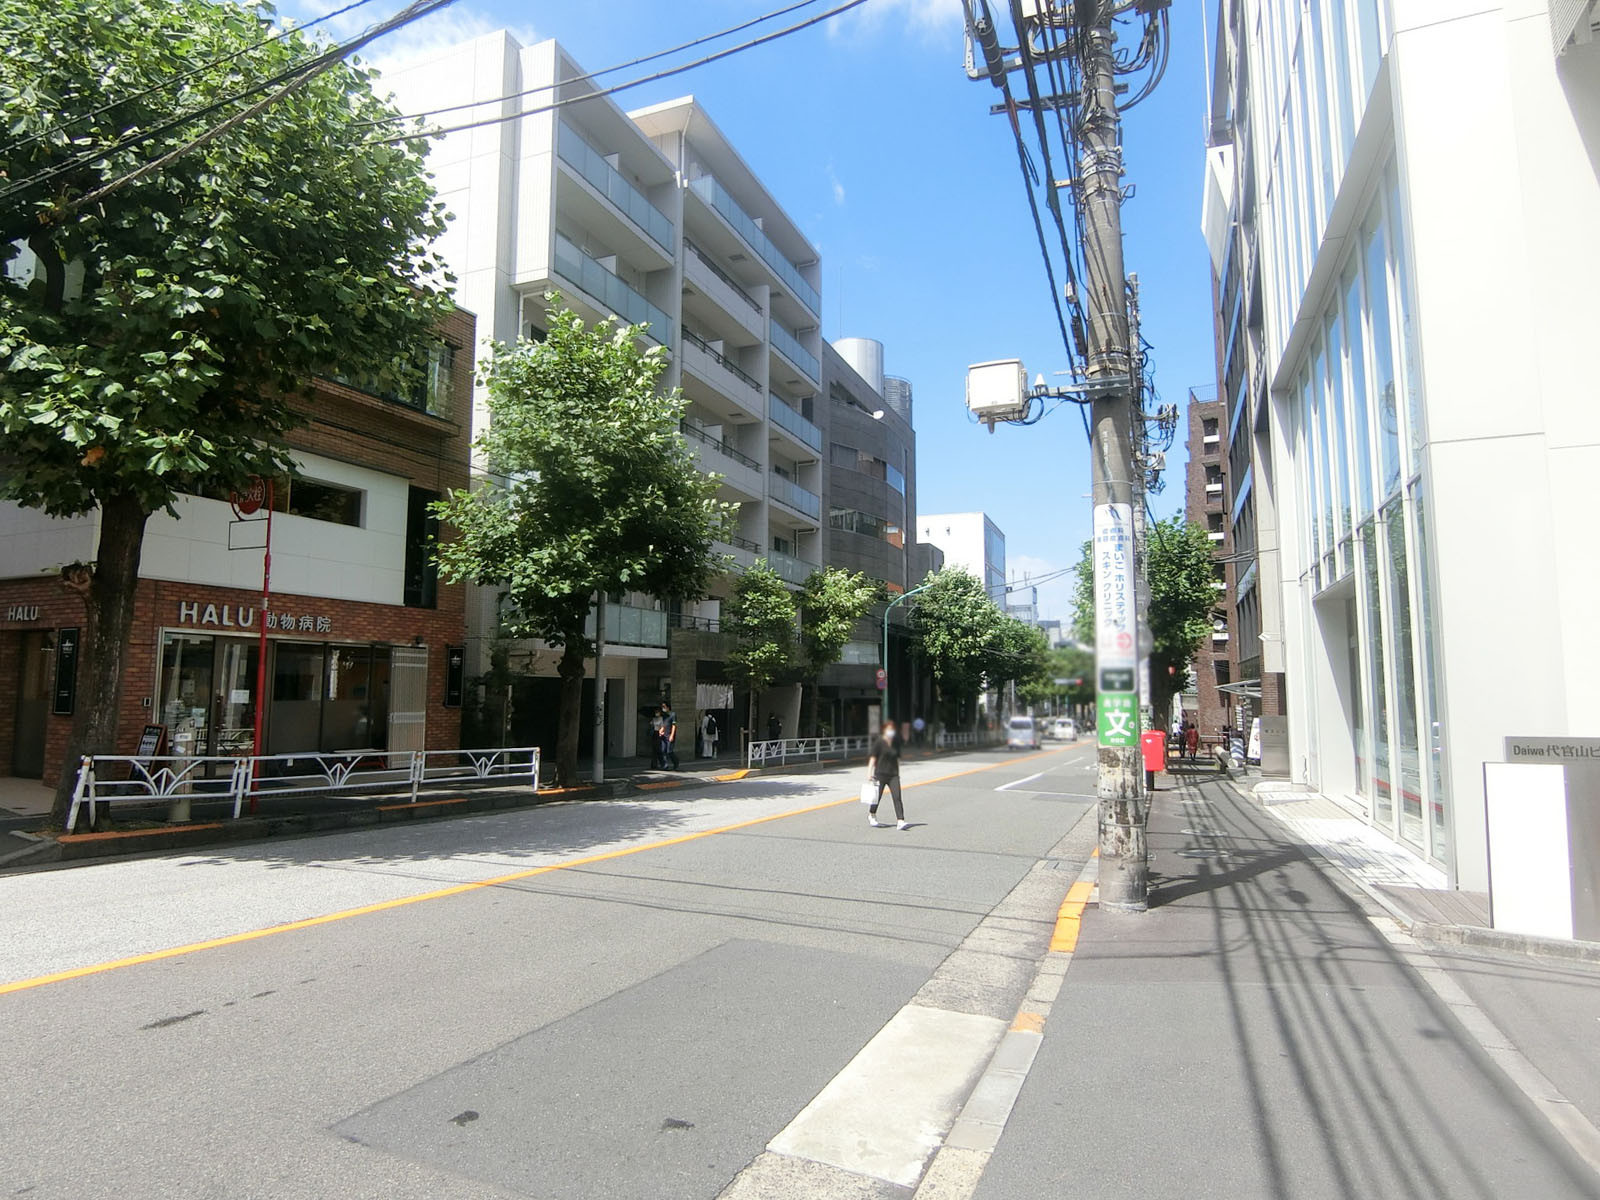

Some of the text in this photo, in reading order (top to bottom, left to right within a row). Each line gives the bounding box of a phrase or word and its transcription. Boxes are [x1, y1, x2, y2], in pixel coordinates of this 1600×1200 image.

[7, 605, 39, 621] HALU
[179, 601, 332, 633] HALU 動物病院
[1104, 708, 1131, 737] 文
[1513, 744, 1545, 756] Daiwa
